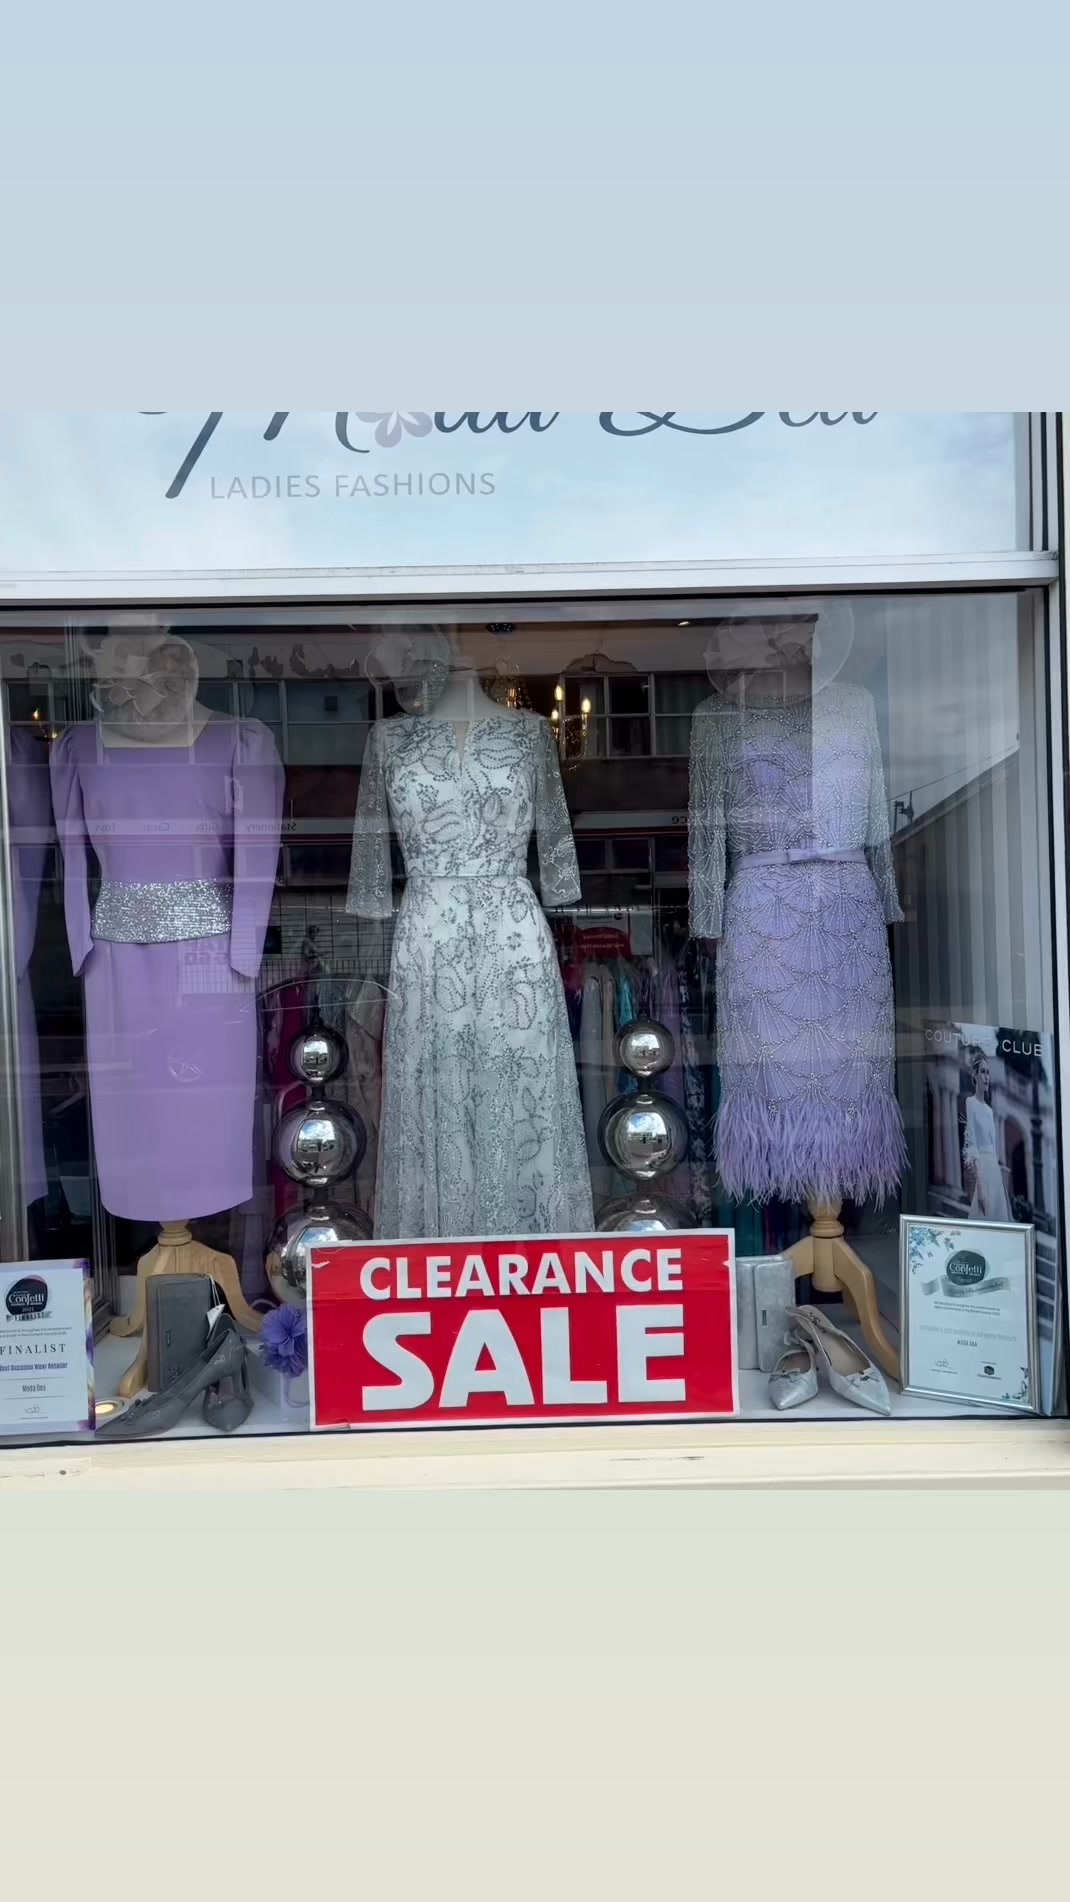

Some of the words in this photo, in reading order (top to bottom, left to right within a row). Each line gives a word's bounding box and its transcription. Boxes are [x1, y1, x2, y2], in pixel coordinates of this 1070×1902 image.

[210, 474, 321, 499] LADIES
[335, 472, 496, 497] FASHIONS
[1001, 1039, 1045, 1057] CLUB
[359, 1248, 683, 1300] CLEARANCE
[0, 1343, 66, 1355] FINALIST
[361, 1303, 687, 1412] SALE
